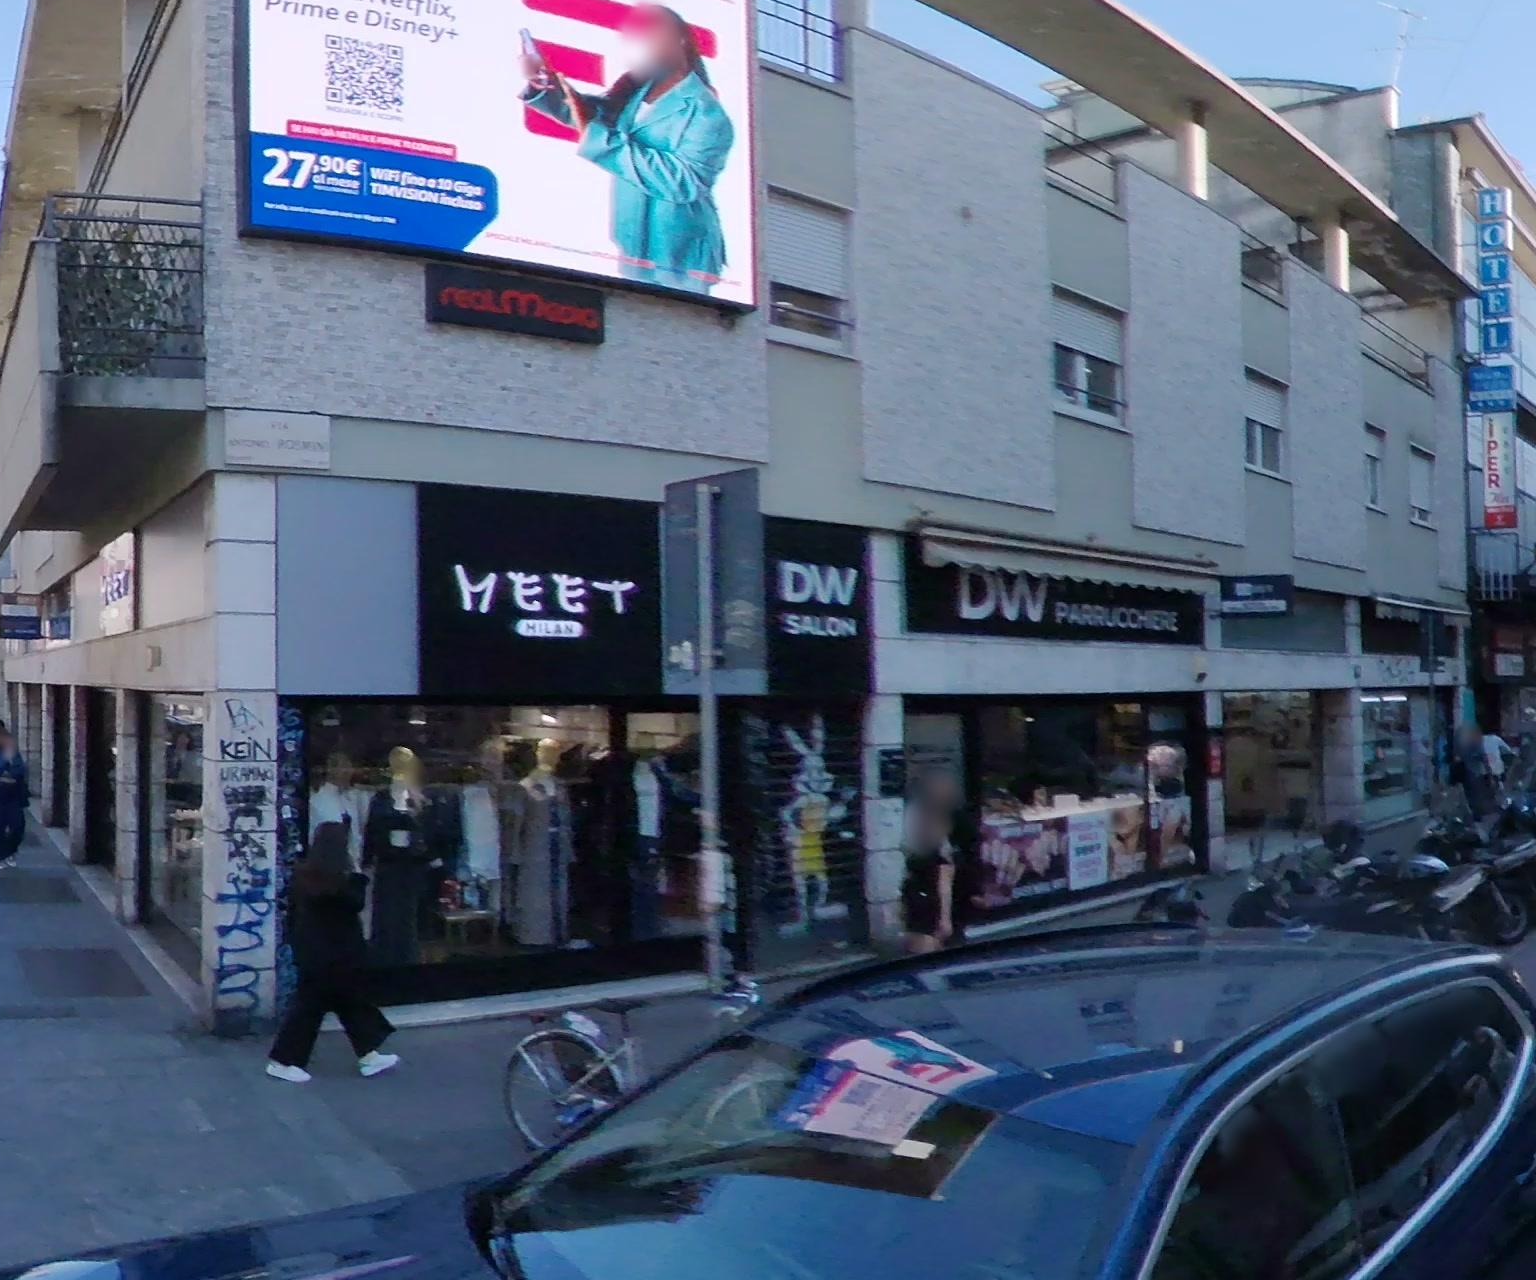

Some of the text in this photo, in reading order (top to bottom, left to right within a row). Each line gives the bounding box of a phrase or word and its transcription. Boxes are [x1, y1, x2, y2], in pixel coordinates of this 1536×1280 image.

[345, 9, 360, 24] e
[365, 9, 460, 43] Disney+
[312, 173, 327, 185] al
[328, 176, 360, 190] mese
[401, 170, 426, 188] fino
[1482, 192, 1509, 349] HOTEL
[454, 564, 637, 615] MEET
[779, 560, 858, 606] DW
[959, 565, 1180, 633] DW PARRUCCHIERE
[525, 623, 575, 635] MILAN
[784, 613, 858, 638] SALON
